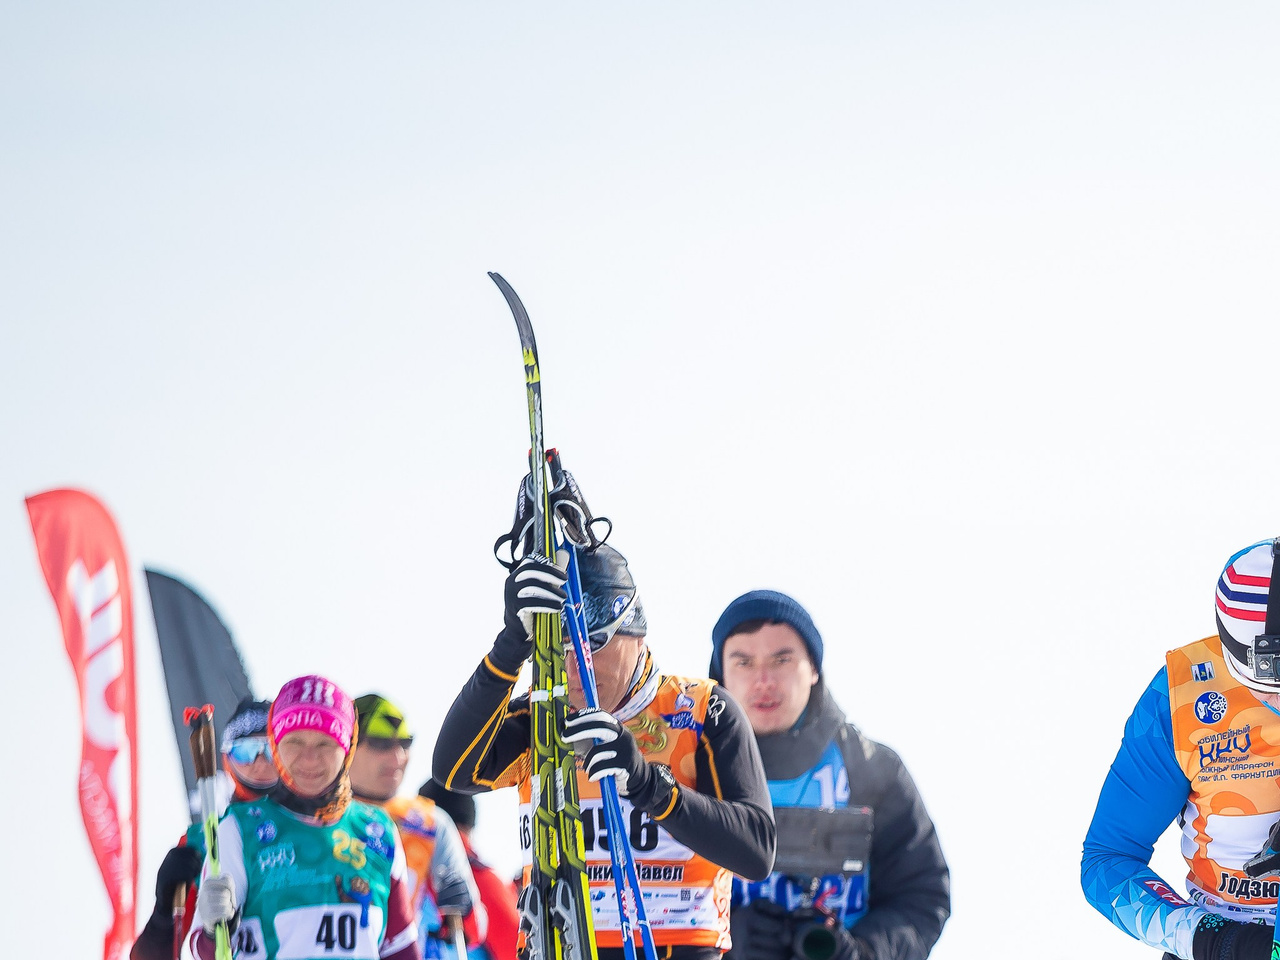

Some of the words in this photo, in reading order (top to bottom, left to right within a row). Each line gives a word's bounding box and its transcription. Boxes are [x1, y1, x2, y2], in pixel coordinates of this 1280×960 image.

[1197, 723, 1251, 746] ЮБИЛЕЙНЫЙ
[1230, 760, 1275, 772] МАРАФОН
[315, 913, 358, 951] 40
